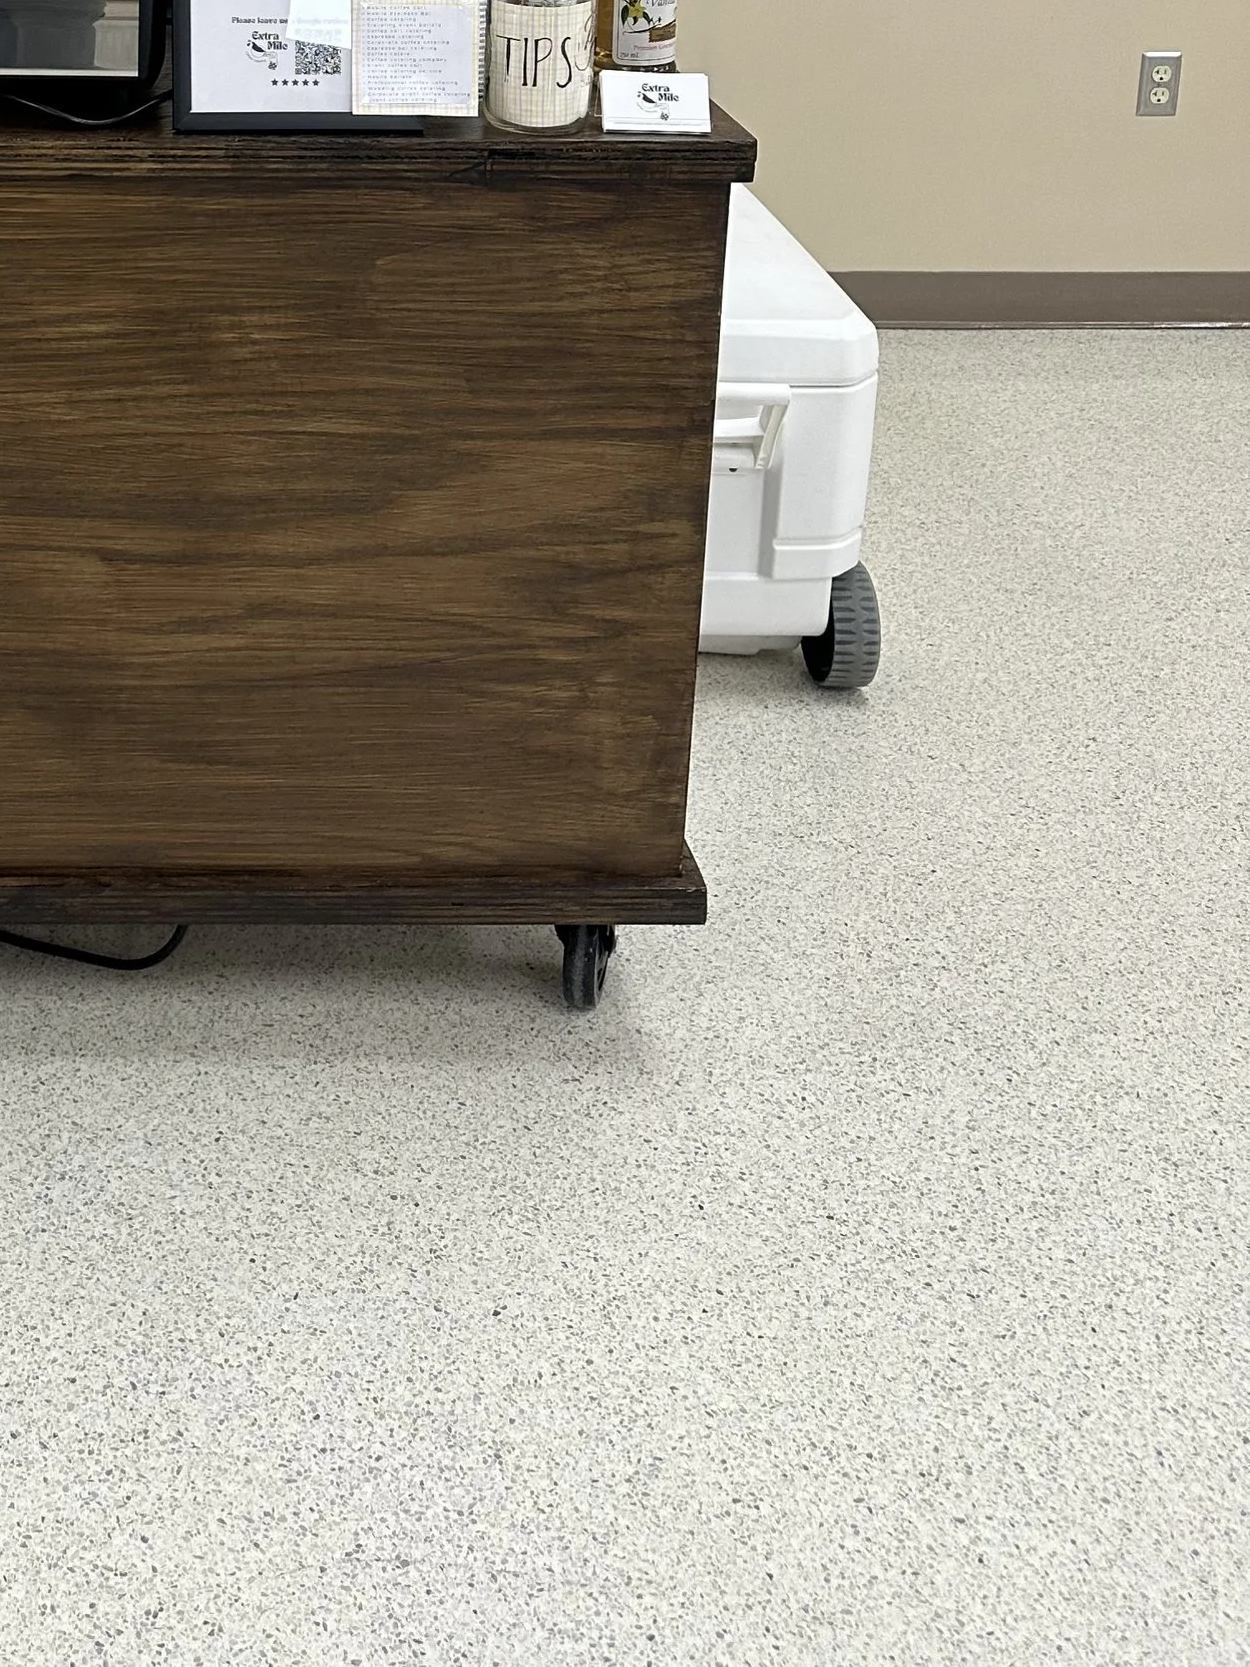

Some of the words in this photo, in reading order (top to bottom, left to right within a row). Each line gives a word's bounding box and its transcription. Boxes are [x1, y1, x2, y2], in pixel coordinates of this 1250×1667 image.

[231, 16, 256, 24] Please
[251, 30, 280, 41] Extra
[267, 40, 289, 51] Mile
[495, 33, 573, 89] TIPS
[641, 82, 670, 93] Extra
[658, 92, 680, 102] Mile
